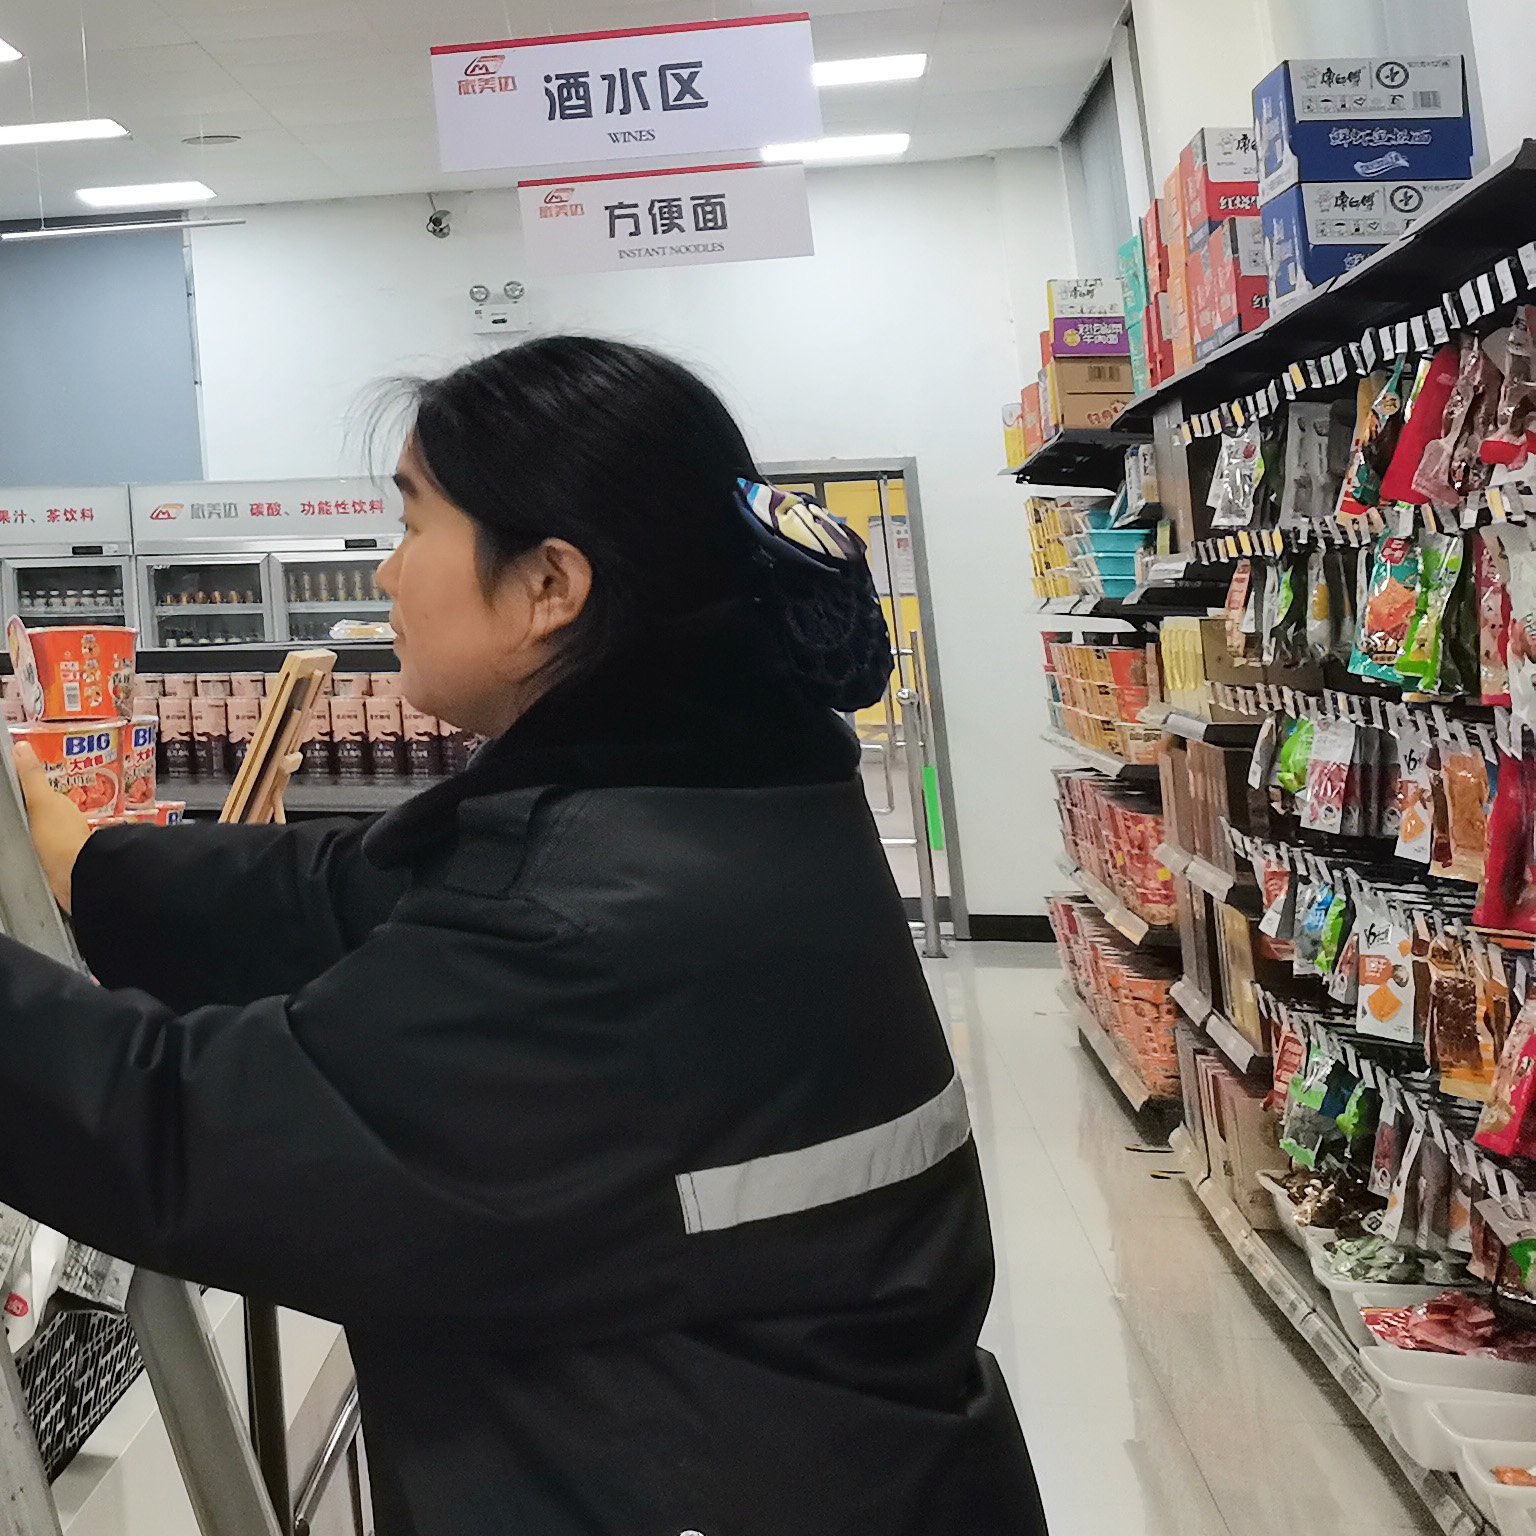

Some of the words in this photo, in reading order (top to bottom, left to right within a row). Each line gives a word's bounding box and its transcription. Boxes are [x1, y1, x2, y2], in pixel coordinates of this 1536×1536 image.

[543, 61, 709, 121] 酒水区
[607, 129, 656, 144] WINES
[604, 194, 728, 239] 方便面
[618, 246, 667, 260] INSTANT
[669, 242, 725, 256] NOODLES
[249, 499, 385, 518] 碳酸、功能性饮料
[65, 733, 111, 756] BIG
